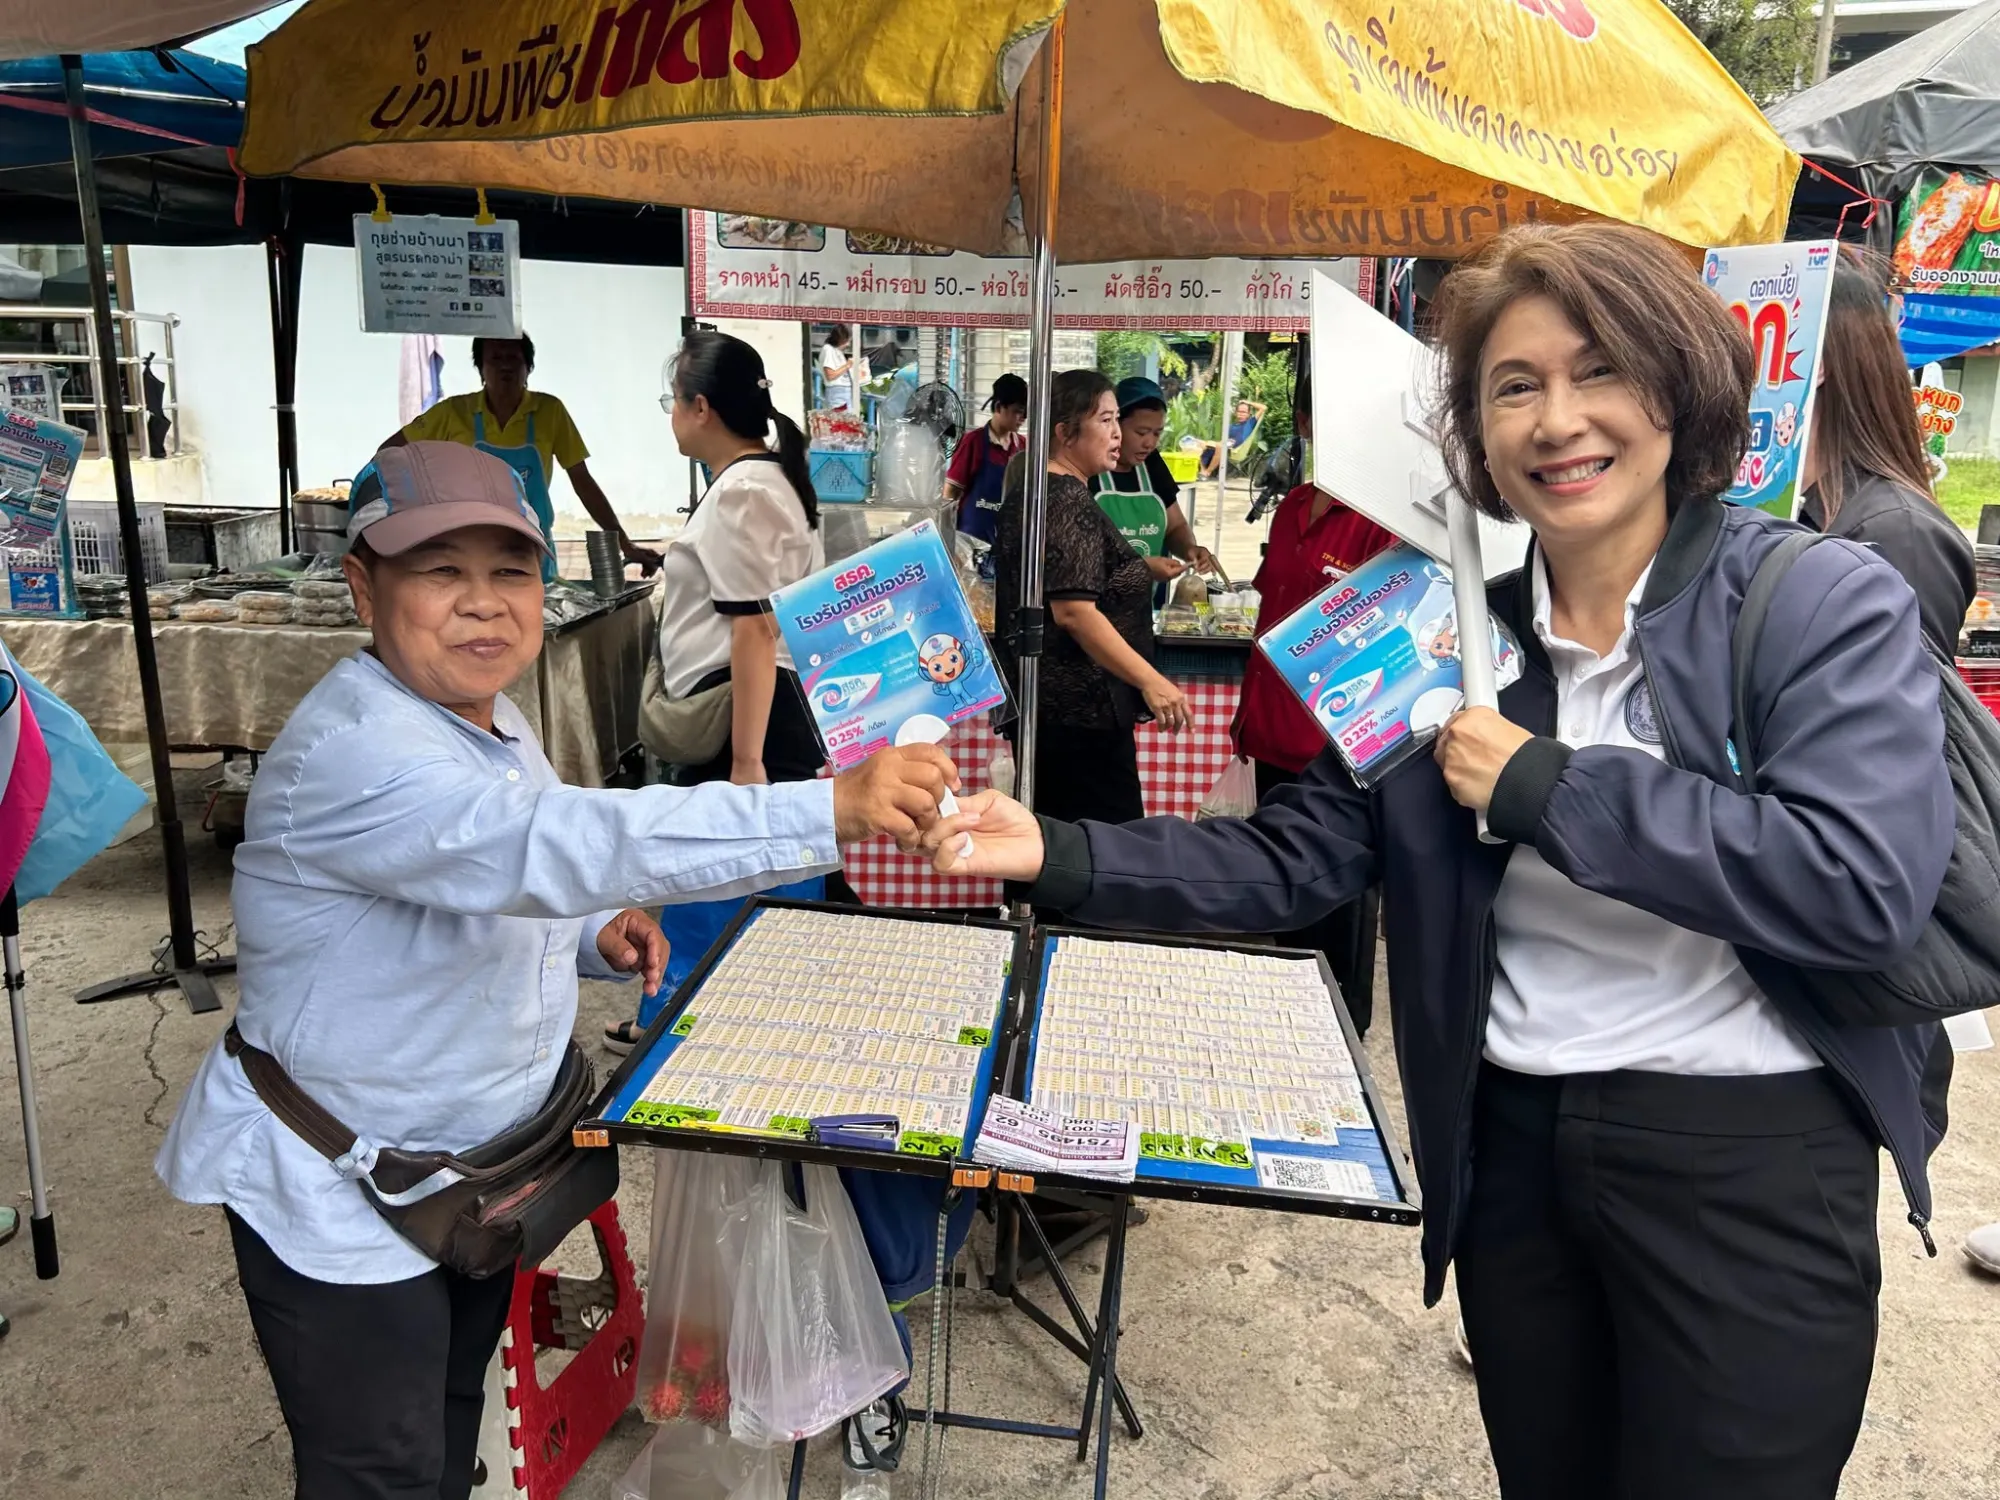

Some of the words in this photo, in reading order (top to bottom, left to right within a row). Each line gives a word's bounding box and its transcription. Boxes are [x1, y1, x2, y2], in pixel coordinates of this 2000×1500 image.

[371, 24, 582, 129] น้ำมันพืช
[371, 230, 465, 249] กุยช่ายบ้านนา
[718, 264, 791, 289] ราดหน้า
[846, 263, 927, 295] หมี่กรอบ
[1105, 265, 1173, 299] ผัดซีอิ๊ว
[1246, 269, 1293, 300] คั่วไก่
[1750, 264, 1796, 298] ดอกเบี้ย
[834, 562, 875, 592] สธค.
[795, 562, 928, 631] โรงรับจำนำของรัฐ
[1319, 585, 1360, 617] สธค.
[861, 603, 887, 623] TOP
[1287, 569, 1413, 660] โรงรับจำนำของรัฐ
[995, 1114, 1019, 1128] 62
[1038, 1128, 1112, 1147] 751495
